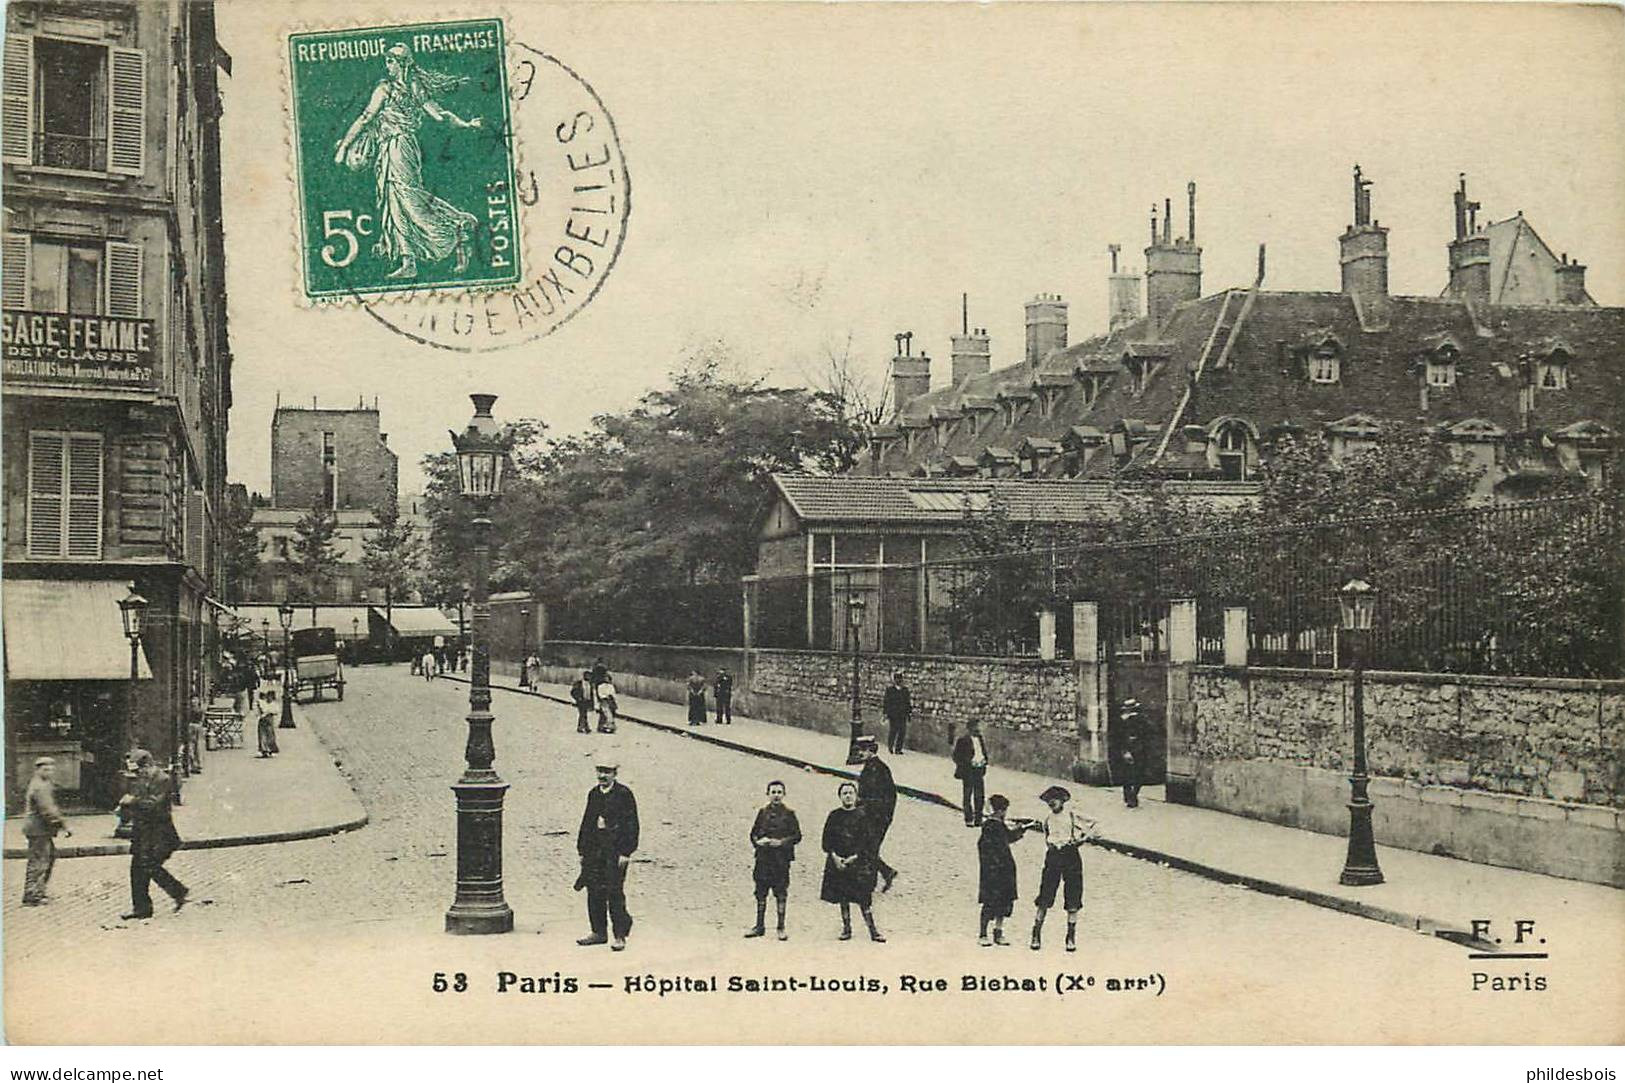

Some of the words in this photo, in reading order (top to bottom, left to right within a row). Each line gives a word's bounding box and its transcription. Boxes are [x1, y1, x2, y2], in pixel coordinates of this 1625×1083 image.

[298, 35, 388, 63] REPUBLIQUE
[413, 29, 497, 56] FRANÇAISE
[490, 180, 511, 268] POSTES
[8, 346, 33, 357] DE
[56, 349, 139, 363] CLASSE
